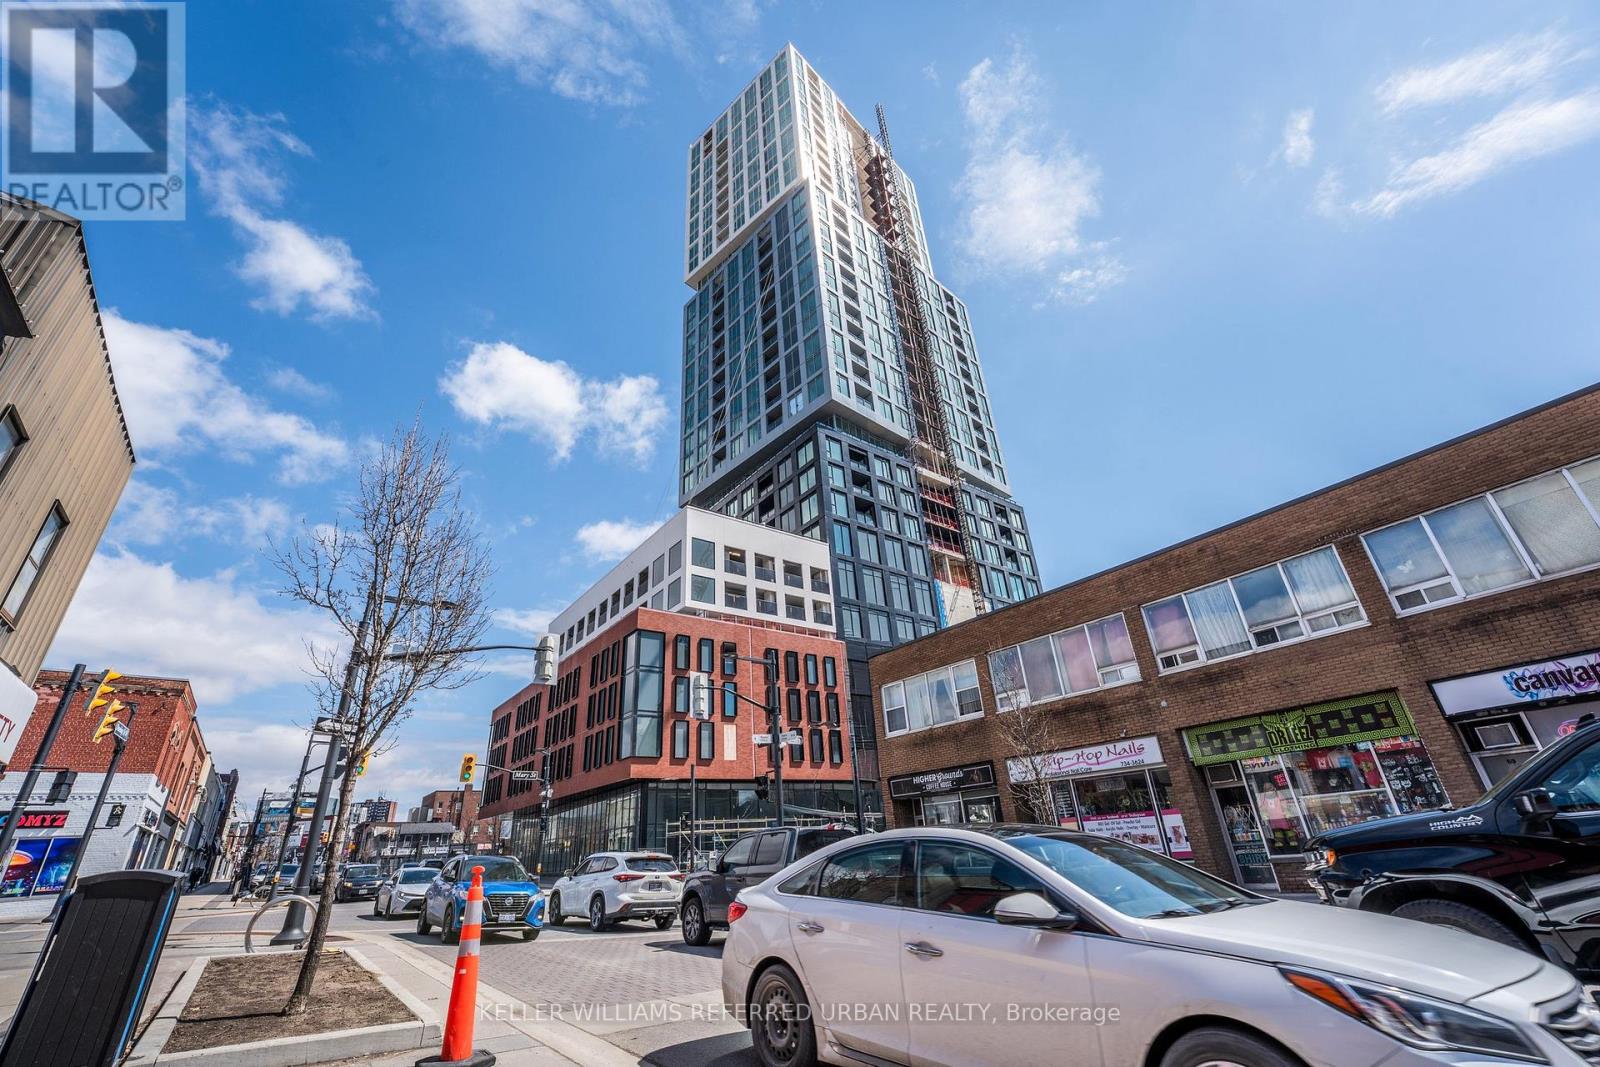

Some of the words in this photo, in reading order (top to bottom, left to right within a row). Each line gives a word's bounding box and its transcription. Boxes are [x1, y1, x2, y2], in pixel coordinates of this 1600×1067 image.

[1106, 741, 1145, 757] Nails
[1273, 742, 1315, 753] CLOTHING
[913, 773, 937, 784] HIGHER
[1431, 821, 1482, 831] COUNTRY
